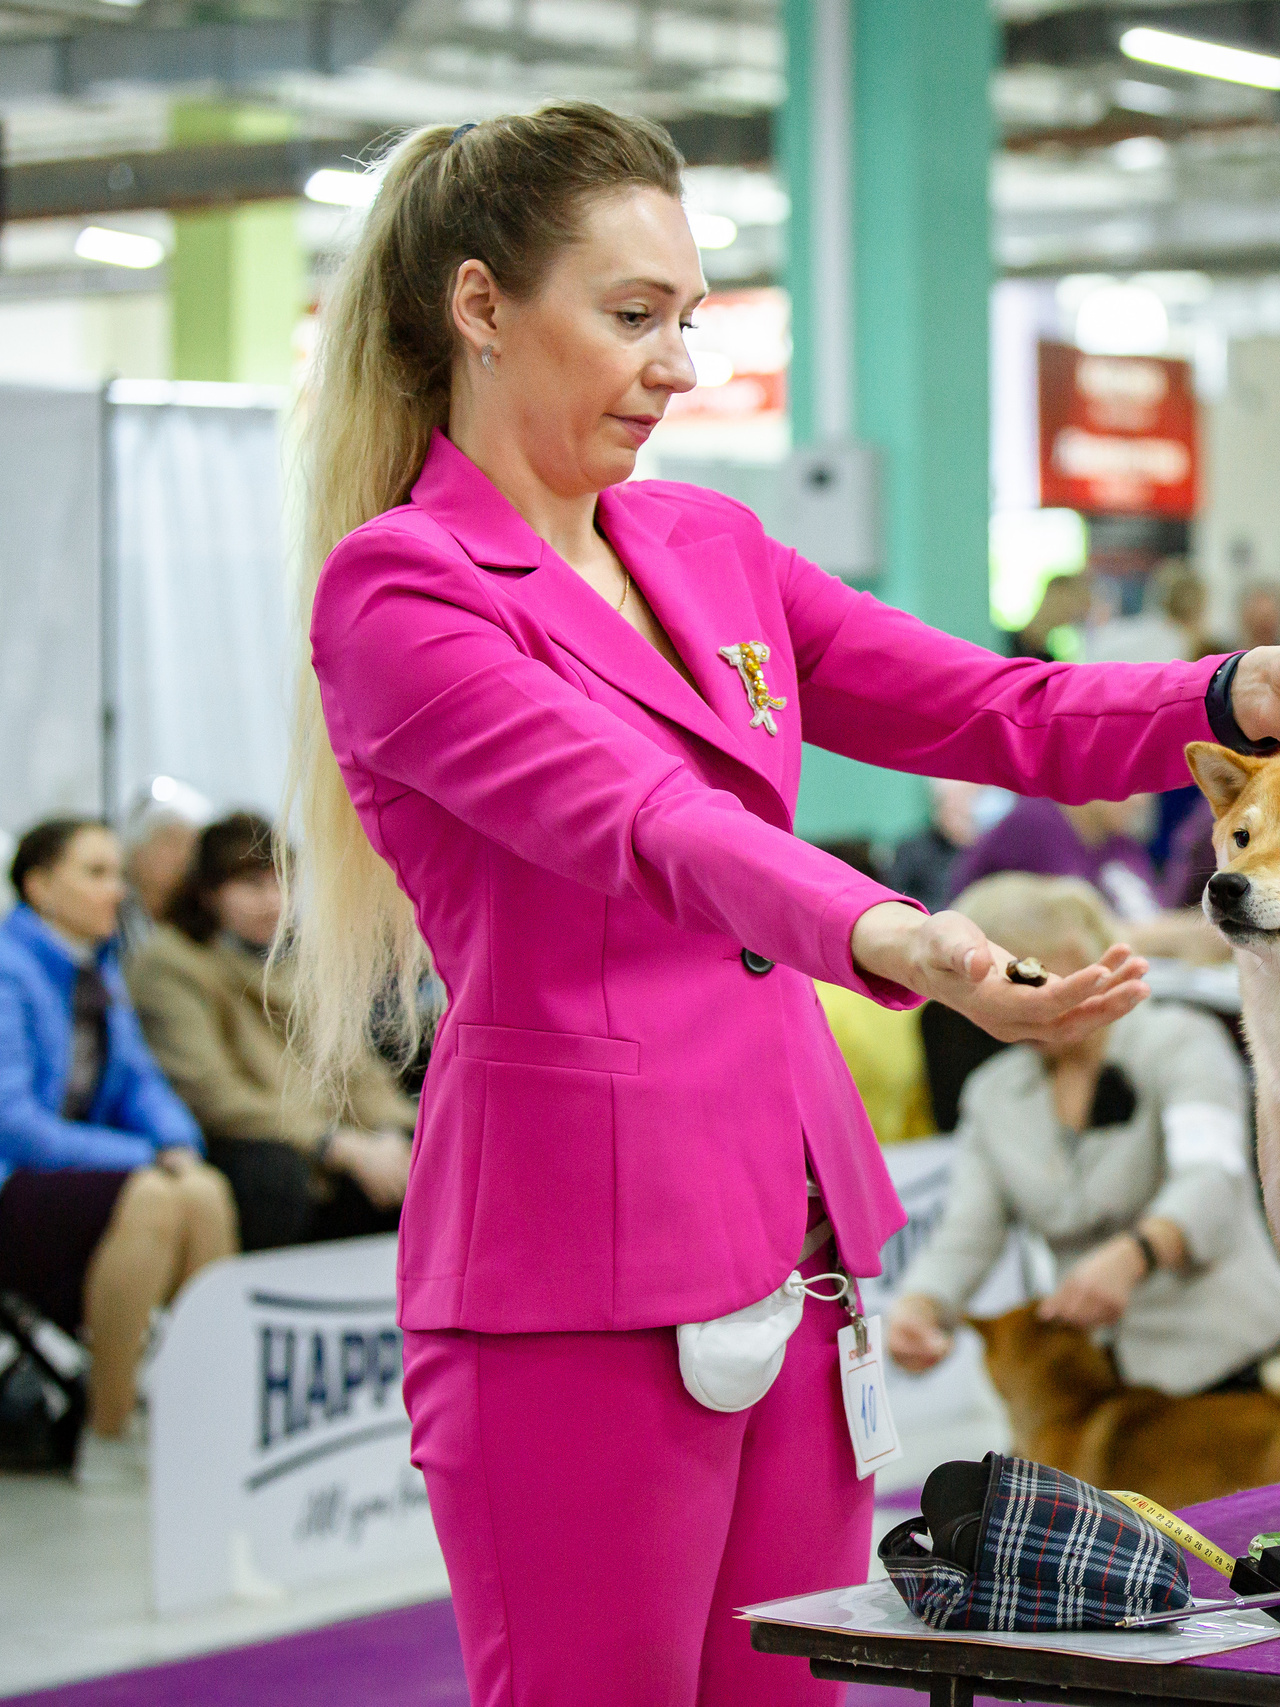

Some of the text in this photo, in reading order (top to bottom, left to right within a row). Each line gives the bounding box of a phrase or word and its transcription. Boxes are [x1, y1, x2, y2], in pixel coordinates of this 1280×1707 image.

[1146, 1507, 1156, 1515] 21
[1156, 1513, 1165, 1522] 22
[1165, 1520, 1174, 1529] 23
[1174, 1527, 1183, 1536] 24
[1184, 1534, 1193, 1543] 25
[1194, 1541, 1203, 1550] 26
[1204, 1548, 1213, 1558] 27
[1214, 1556, 1224, 1565] 28
[1225, 1563, 1234, 1573] 29
